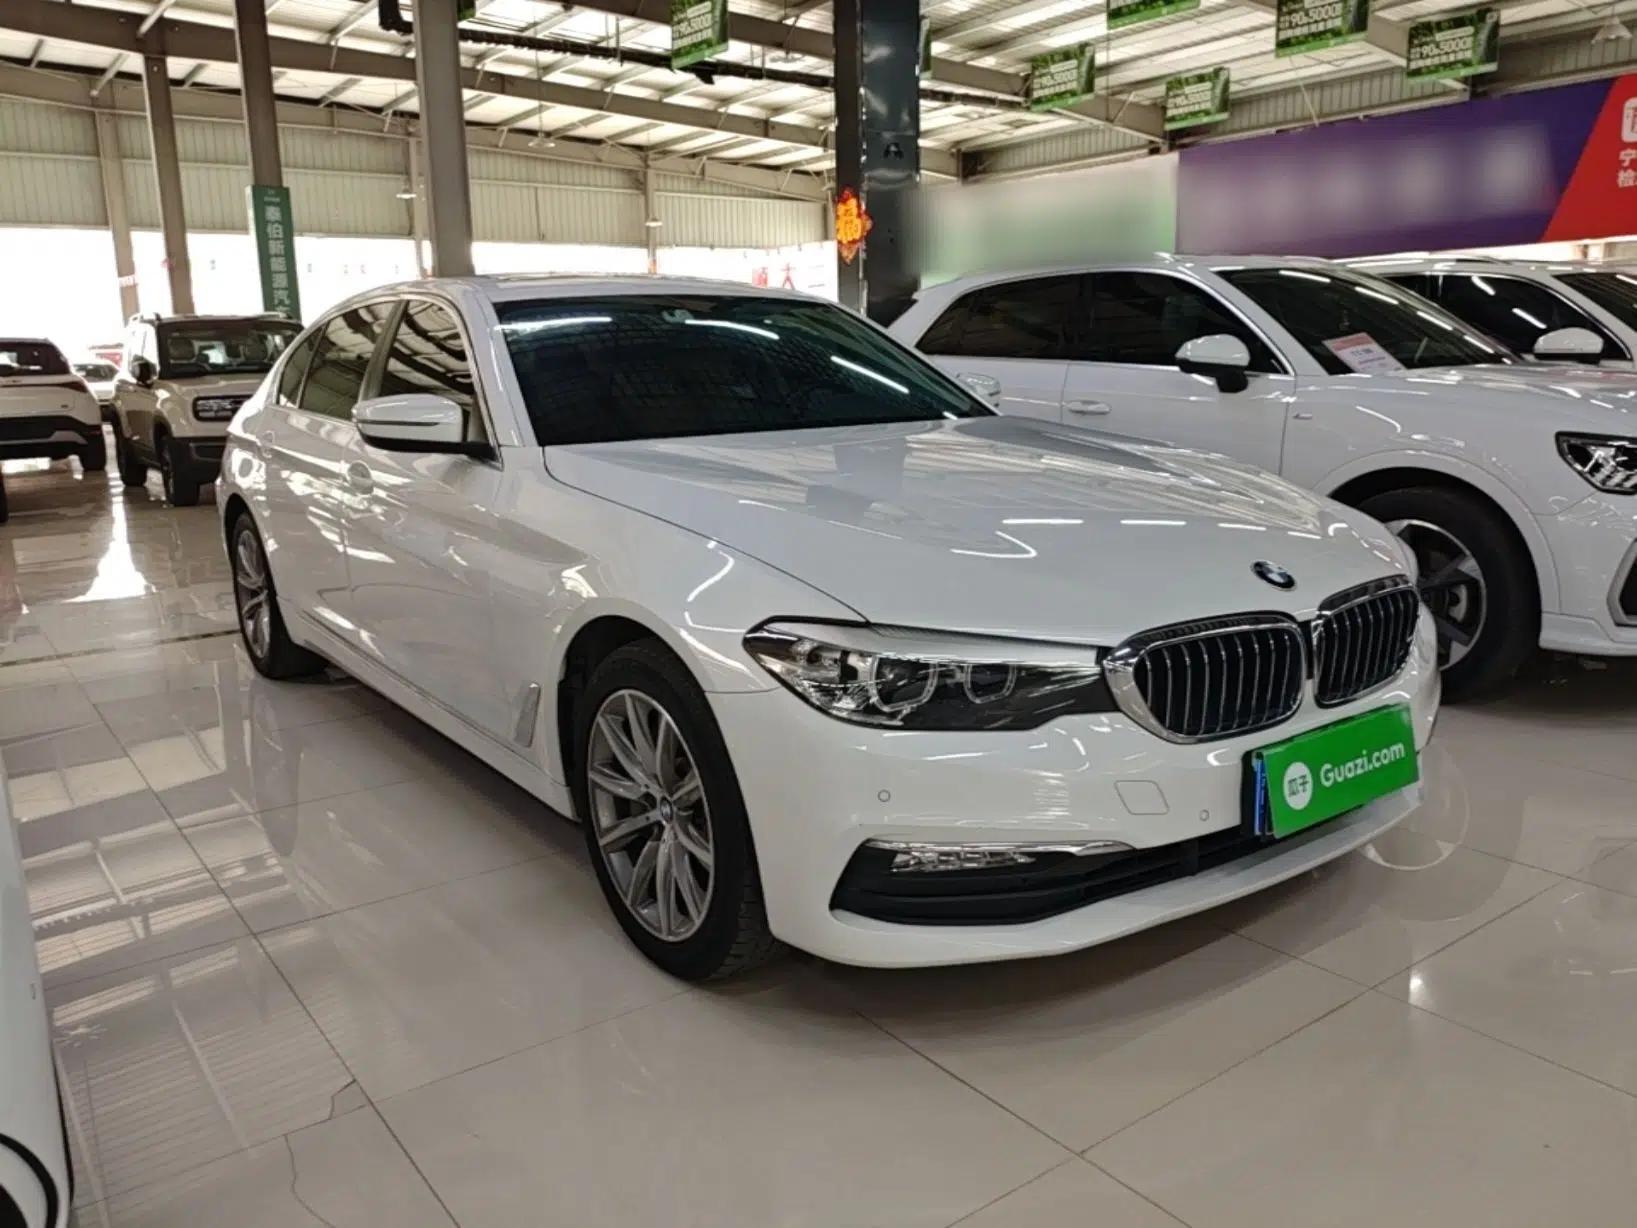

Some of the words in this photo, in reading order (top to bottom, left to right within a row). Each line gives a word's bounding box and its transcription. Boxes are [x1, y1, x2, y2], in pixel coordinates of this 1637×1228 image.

[1617, 168, 1637, 188] 检
[1288, 774, 1309, 797] 瓜子
[1320, 742, 1405, 787] Guazi.com
